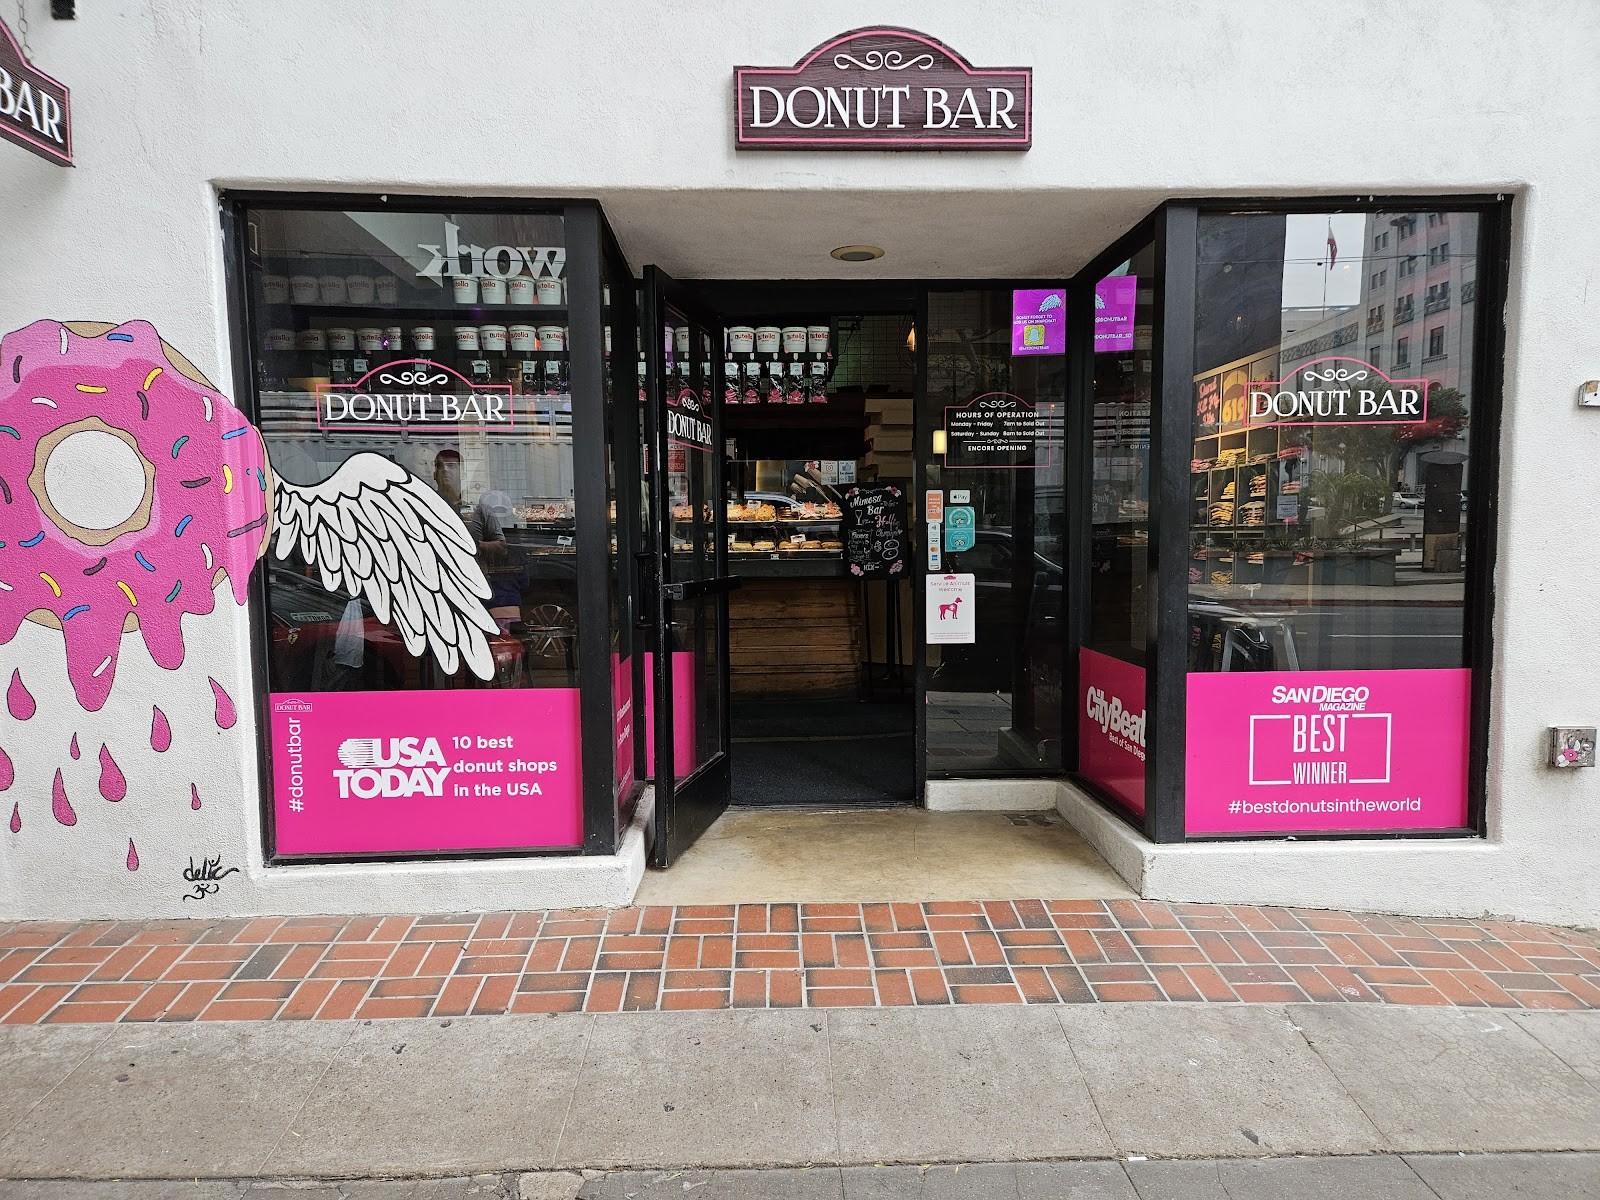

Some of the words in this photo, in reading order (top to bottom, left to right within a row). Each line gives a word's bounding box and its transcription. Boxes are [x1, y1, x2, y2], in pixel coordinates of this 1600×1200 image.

[0, 66, 64, 144] BAR
[749, 84, 910, 129] DONUT
[922, 87, 1018, 130] BAR
[323, 392, 433, 422] DONUT
[440, 393, 507, 422] BAR
[1250, 388, 1351, 417] DONUT
[1356, 388, 1420, 416] BAR
[956, 411, 982, 419] HOURS
[984, 411, 995, 419] OF
[996, 411, 1040, 419] OPERATION
[667, 409, 695, 441] DONUT
[696, 419, 713, 446] BAR
[979, 430, 1000, 438] Sunday
[850, 495, 883, 508] Mimosa
[866, 504, 885, 515] Bar
[1271, 686, 1311, 704] SAN
[1311, 686, 1370, 704] DIEGO
[1086, 685, 1147, 748] CityBeat
[1319, 702, 1366, 712] MAGAZINE
[452, 735, 472, 749] 10
[476, 735, 514, 749] best
[1108, 731, 1119, 745] Best
[1118, 738, 1125, 748] of
[1124, 740, 1133, 754] San
[1292, 713, 1350, 753] BEST
[376, 736, 447, 768] USA
[286, 716, 305, 813] #donutbar
[453, 759, 503, 773] donut
[508, 759, 557, 775] shops
[1292, 761, 1348, 785] WINNER
[332, 766, 452, 799] TODAY
[453, 783, 469, 797] in
[473, 783, 501, 797] the
[506, 782, 543, 796] USA
[1228, 797, 1422, 814] #bestdonutsintheworld
